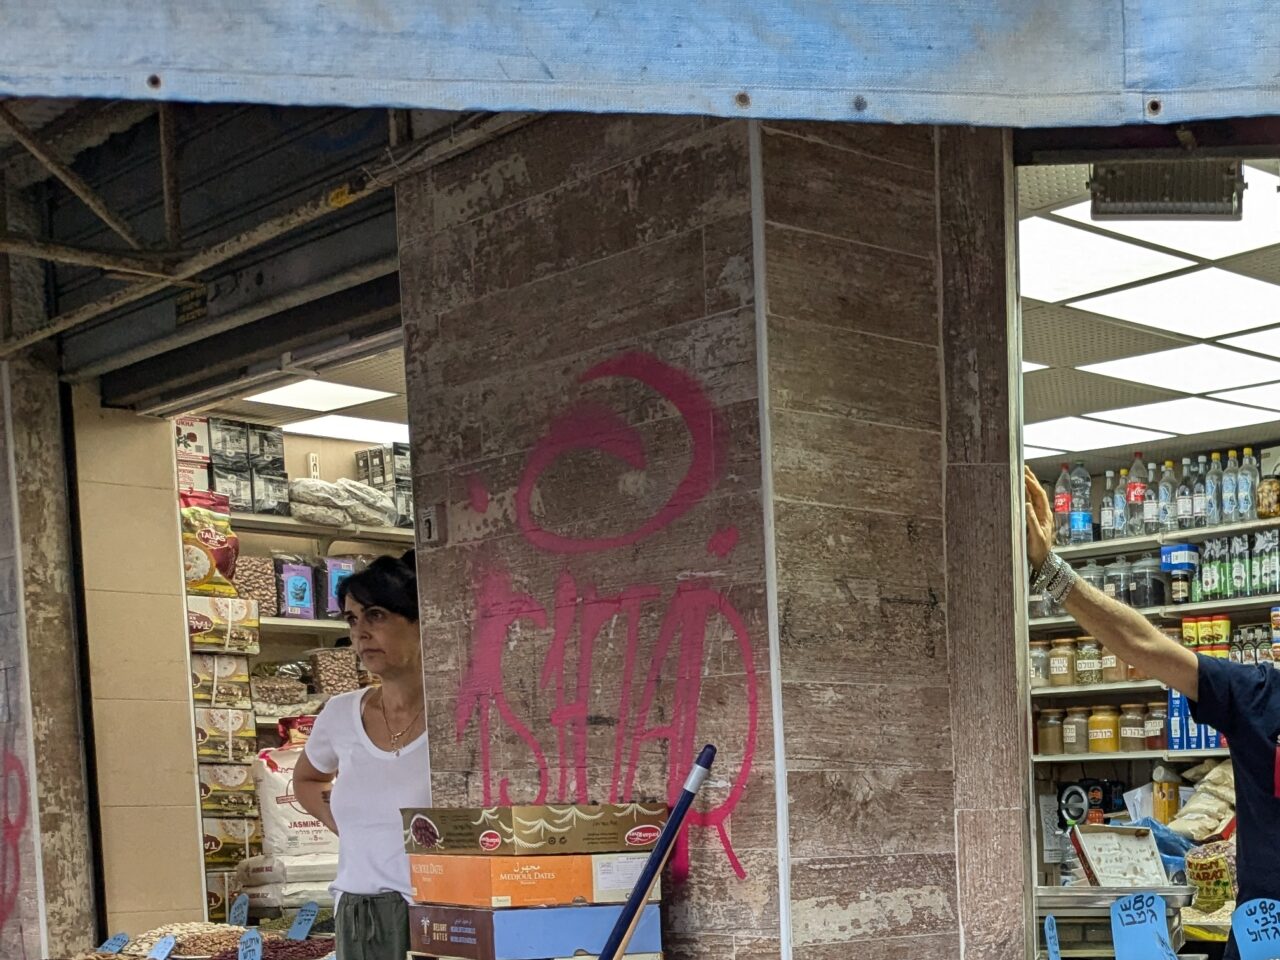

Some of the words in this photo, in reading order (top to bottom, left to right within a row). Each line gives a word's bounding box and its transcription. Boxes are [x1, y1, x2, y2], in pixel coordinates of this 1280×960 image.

[288, 821, 321, 829] JASMINE
[534, 872, 556, 880] DATES
[1132, 894, 1155, 911] 80
[1258, 900, 1276, 914] 80
[1246, 926, 1280, 942] גדול
